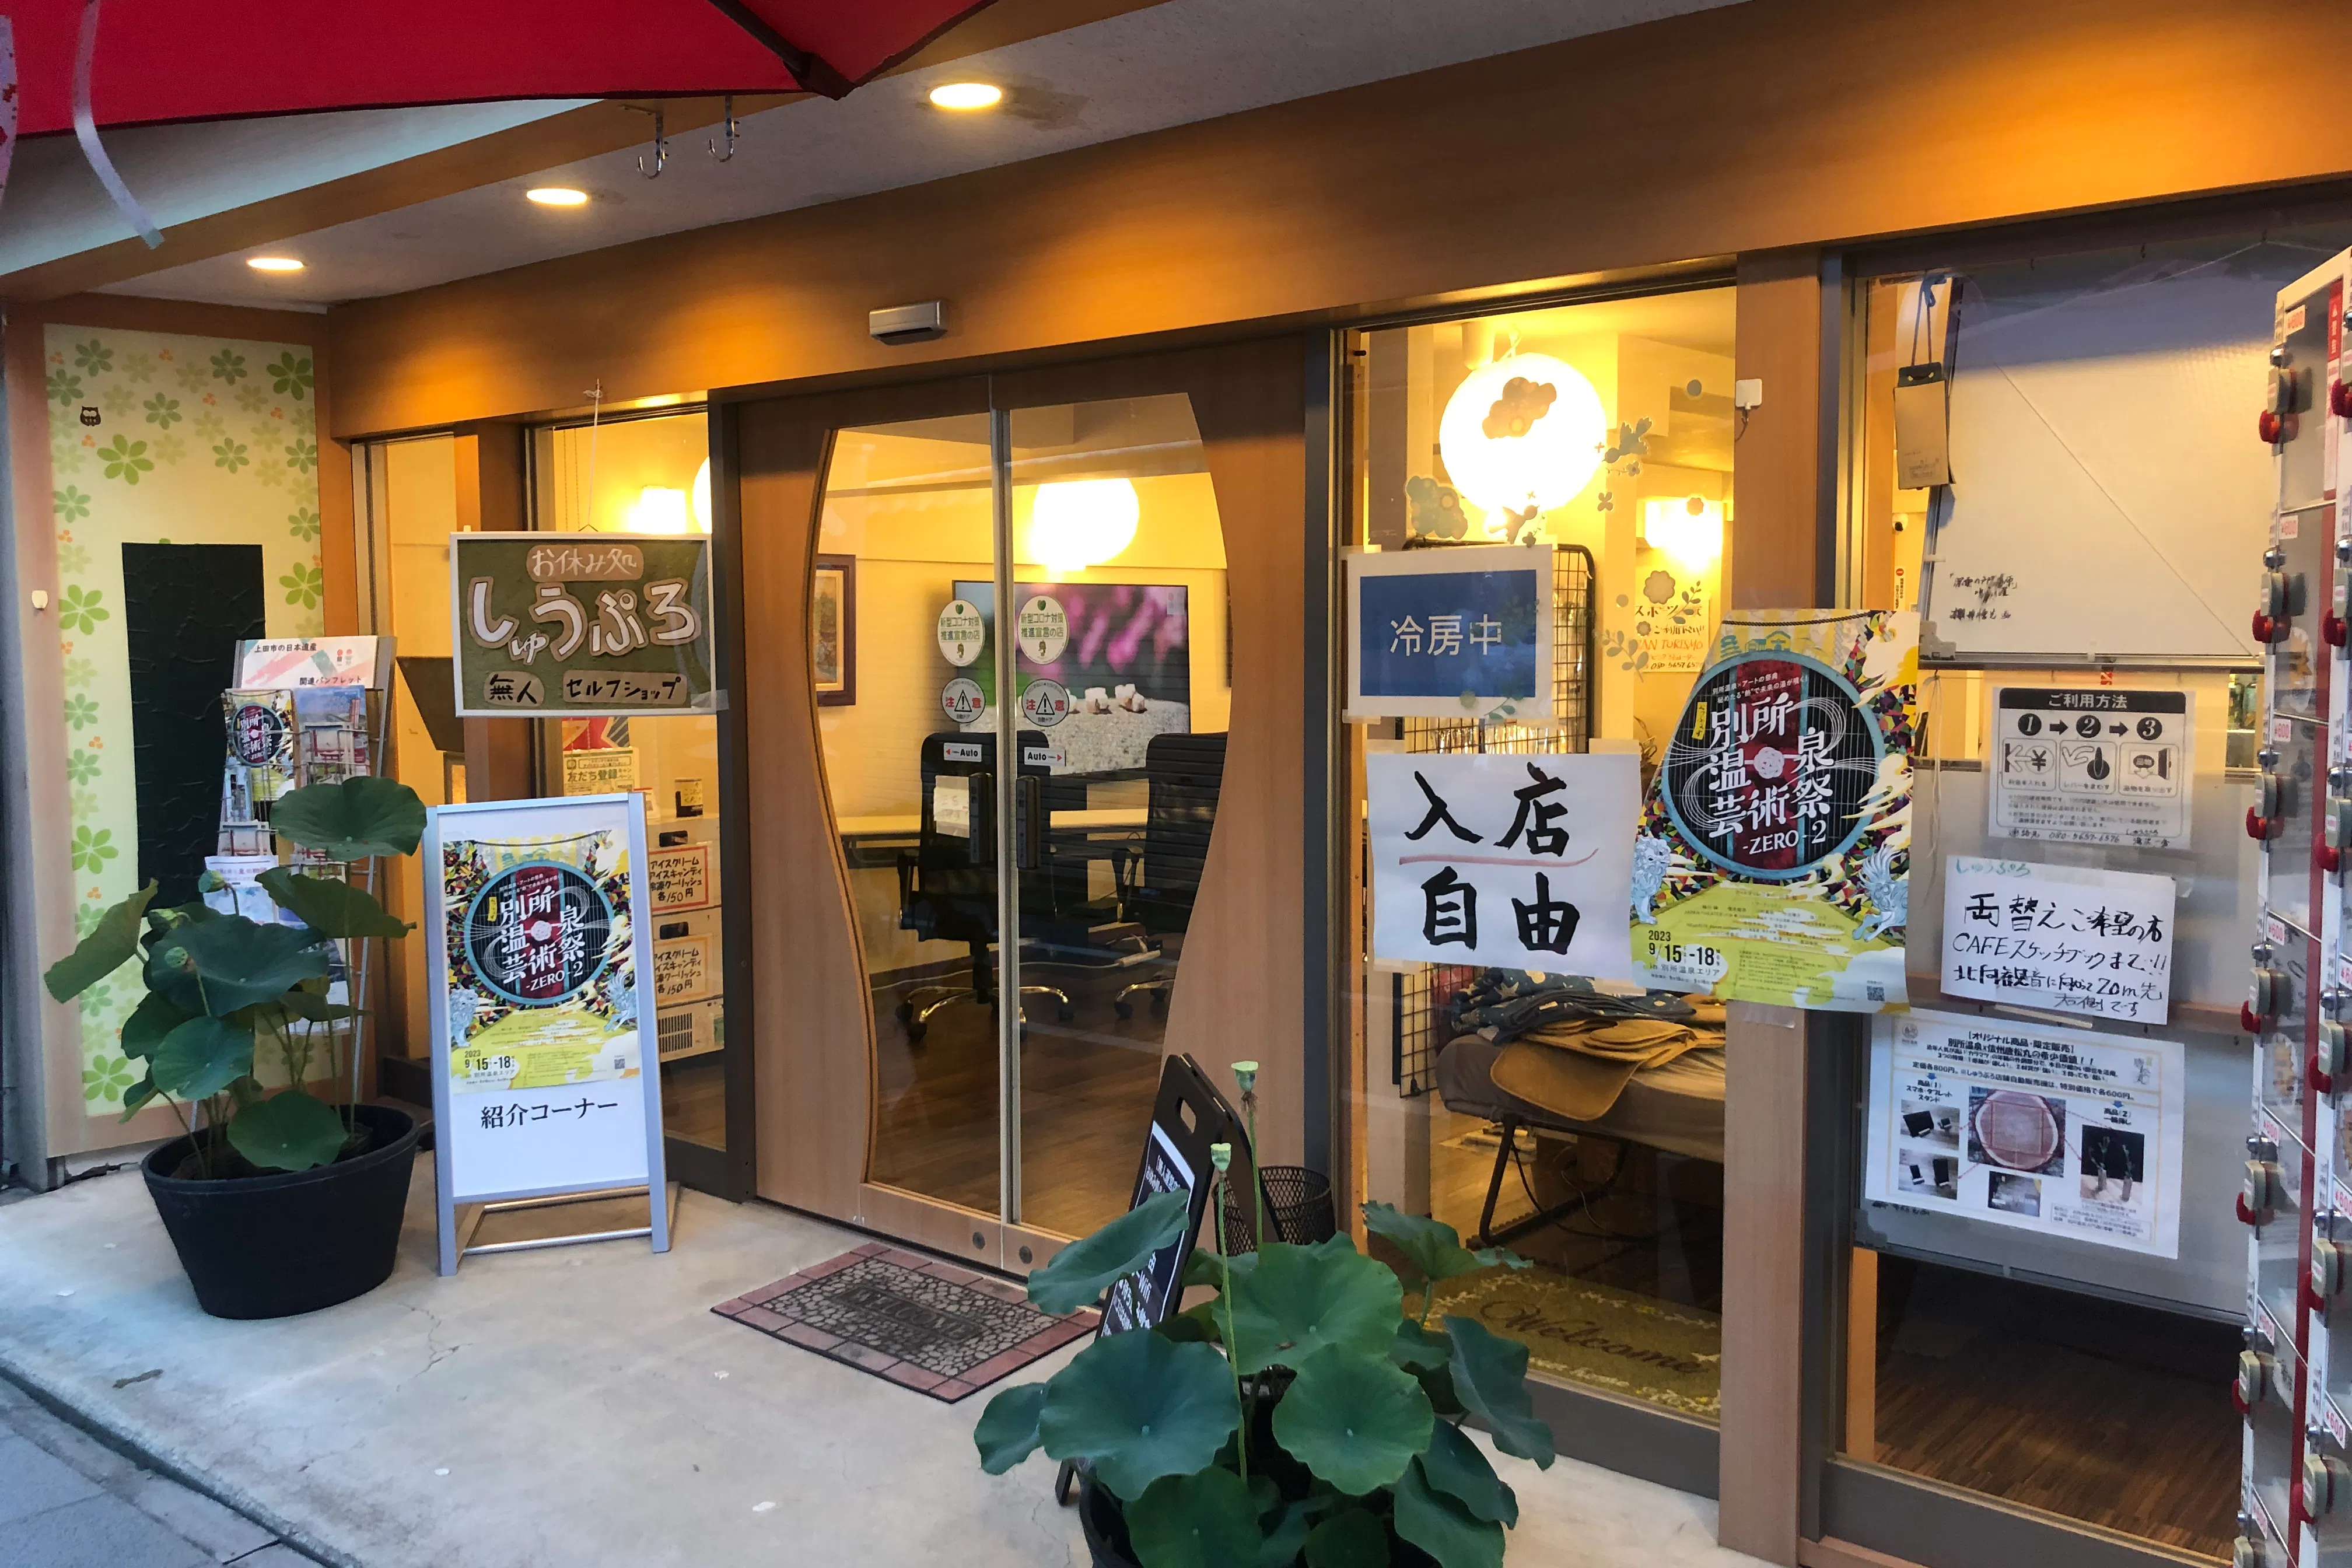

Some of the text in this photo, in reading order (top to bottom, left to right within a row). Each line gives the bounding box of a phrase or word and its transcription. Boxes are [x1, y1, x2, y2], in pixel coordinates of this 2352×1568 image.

[531, 547, 637, 576] お休み処
[473, 582, 695, 664] しゅうぷろ
[1021, 627, 1064, 638] 推進宣言の店
[1390, 614, 1502, 656] 冷房中
[254, 643, 317, 652] 上田市の日本遺産
[299, 676, 362, 686] 関連パンフレット
[489, 674, 681, 704] 無人 セルフショップ
[945, 696, 955, 708] 注
[1026, 699, 1036, 710] 注
[2049, 692, 2128, 709] ご利用方法
[1711, 692, 1793, 751] 別所
[960, 749, 978, 757] Auto
[1027, 752, 1046, 761] Auto
[567, 768, 618, 782] 友だち登録
[1404, 762, 1569, 857] 入店
[1709, 774, 1833, 838] 芸術祭
[650, 856, 699, 869] アイスクリーム
[500, 886, 555, 929] 別所
[1421, 866, 1580, 956] 自由
[1964, 893, 2164, 944] 両替えご希望の方
[1648, 930, 1671, 942] 2023
[502, 933, 584, 984] 芸術祭
[1661, 964, 1720, 976] 別所温泉エリア
[481, 1097, 618, 1129] 紹介コーナー
[1479, 1300, 1710, 1373] Welcome
[2326, 1411, 2343, 1441] ¥600
